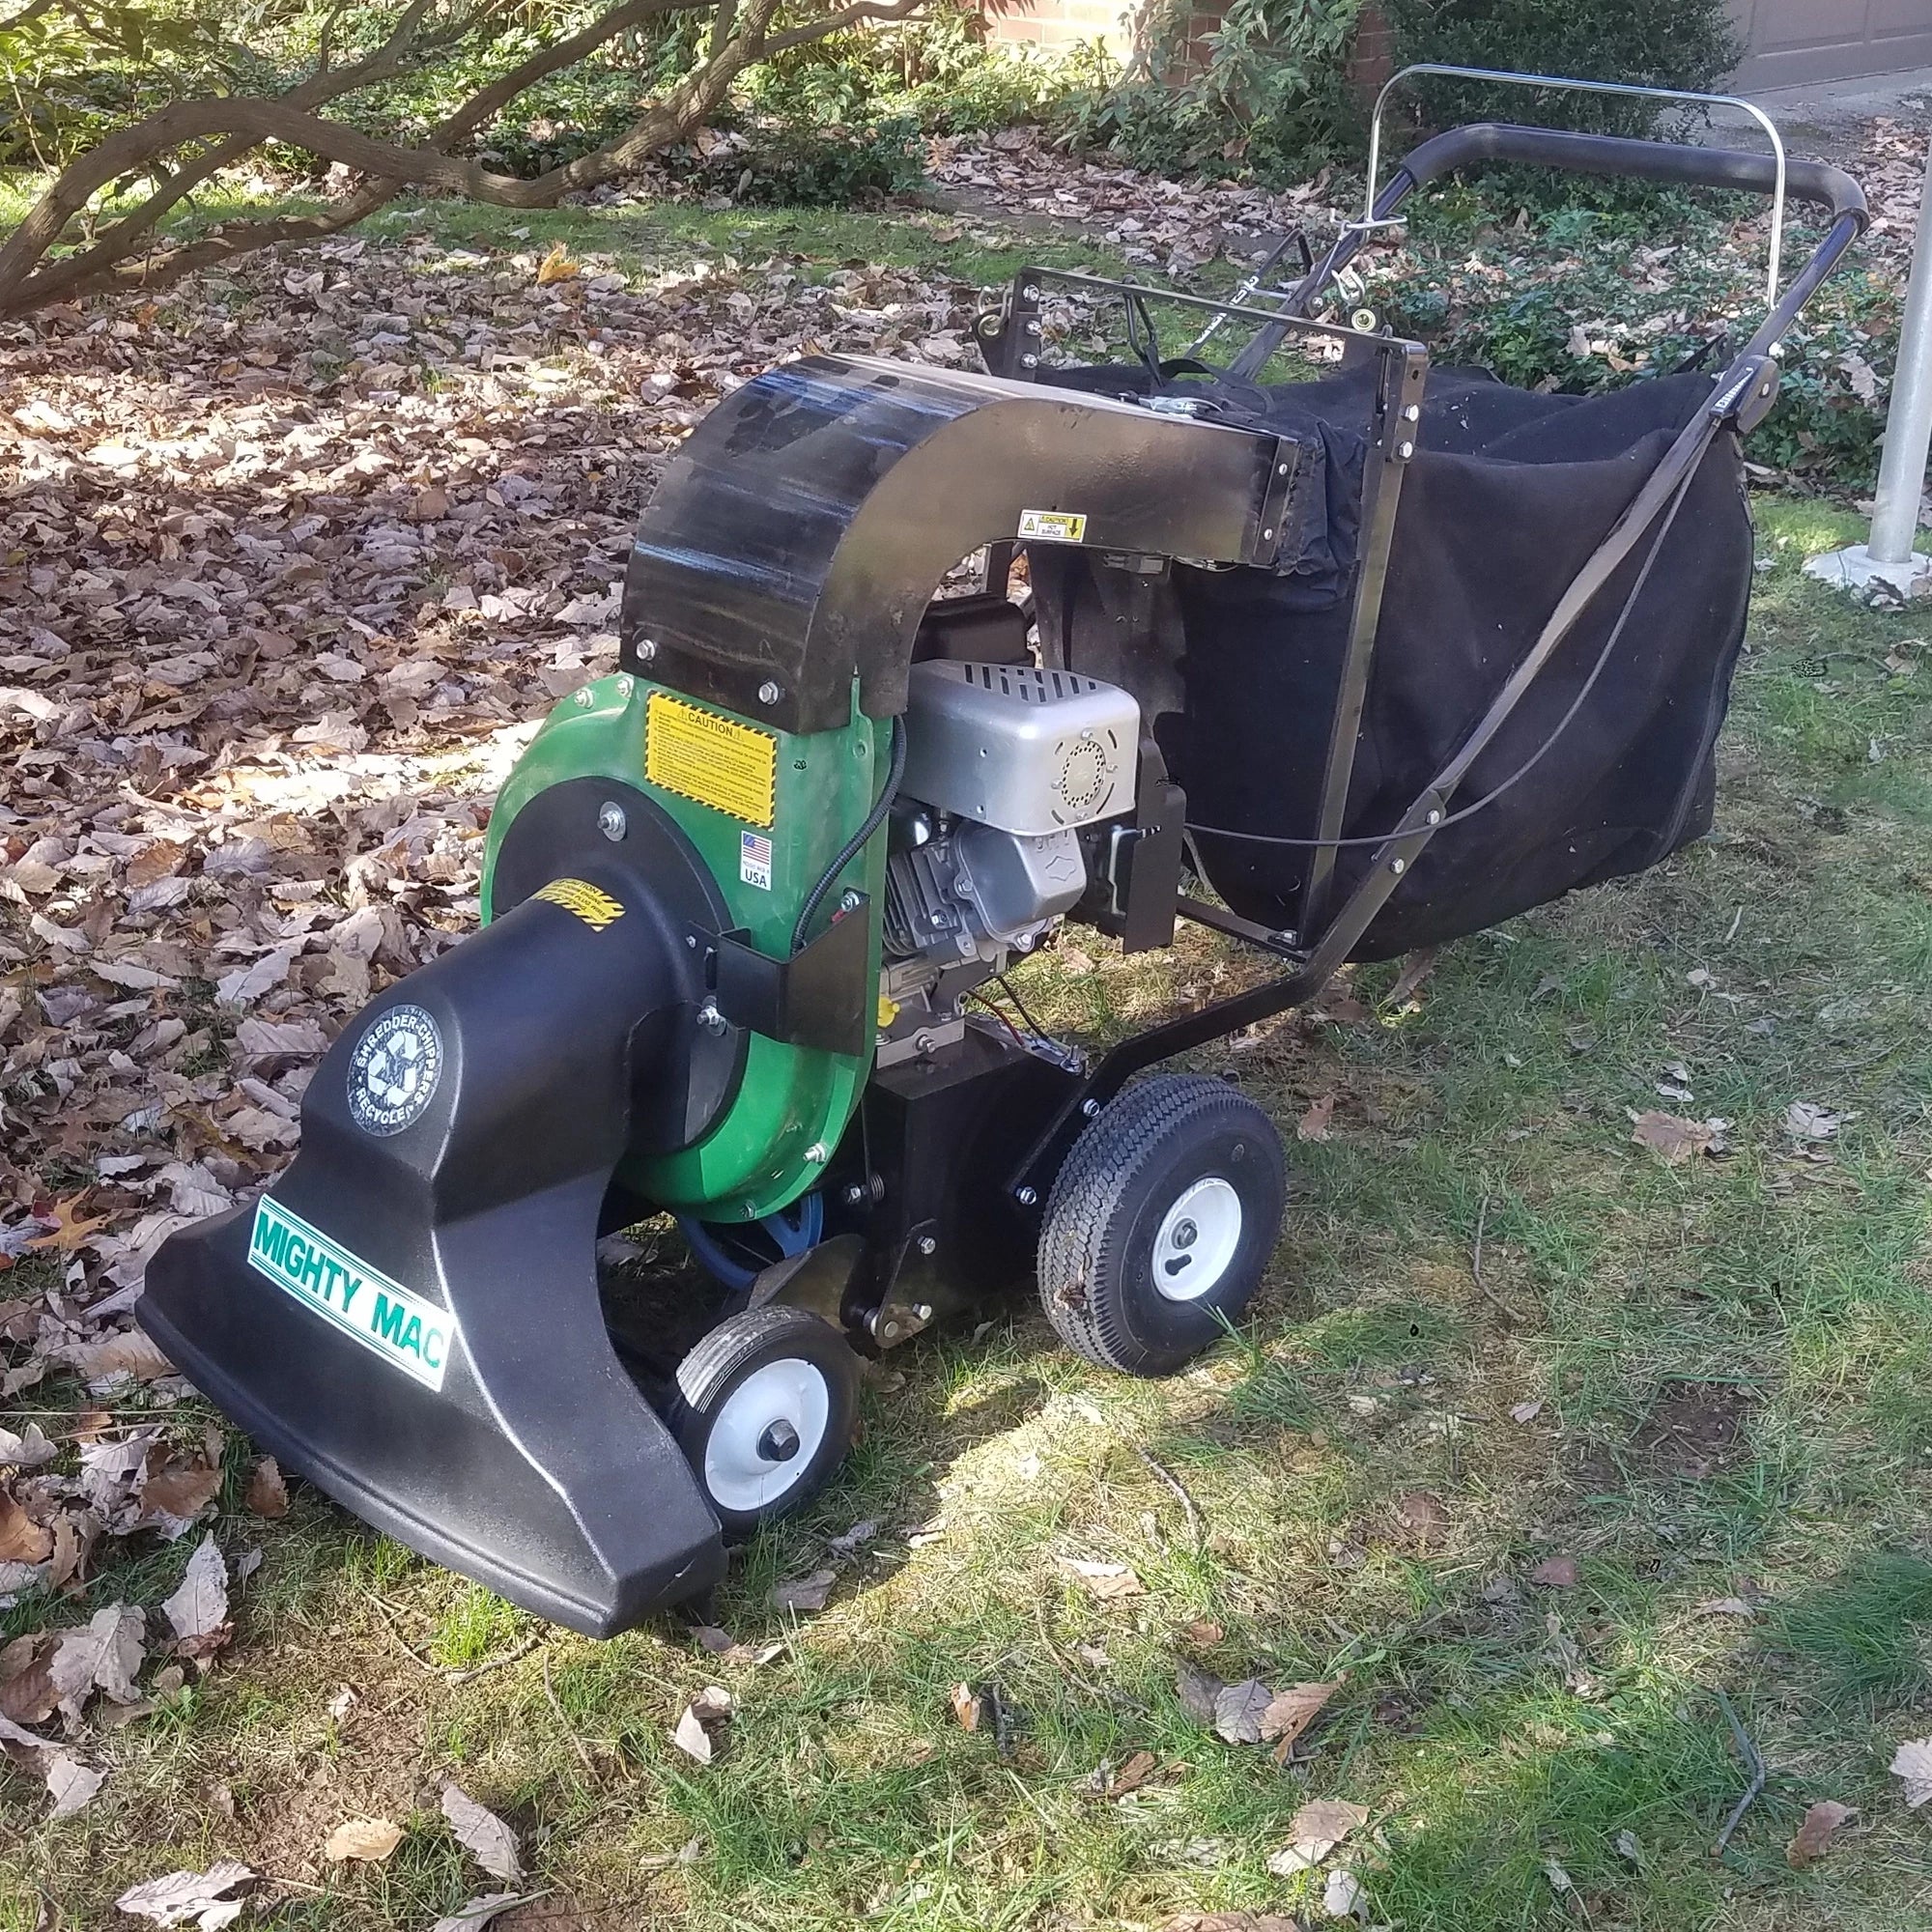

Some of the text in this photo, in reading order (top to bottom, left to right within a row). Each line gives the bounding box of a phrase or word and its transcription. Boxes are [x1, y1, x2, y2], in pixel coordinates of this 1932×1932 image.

[688, 712, 733, 736] CAUTION
[745, 867, 767, 888] USA
[253, 1209, 444, 1369] MIGHTY MAC
